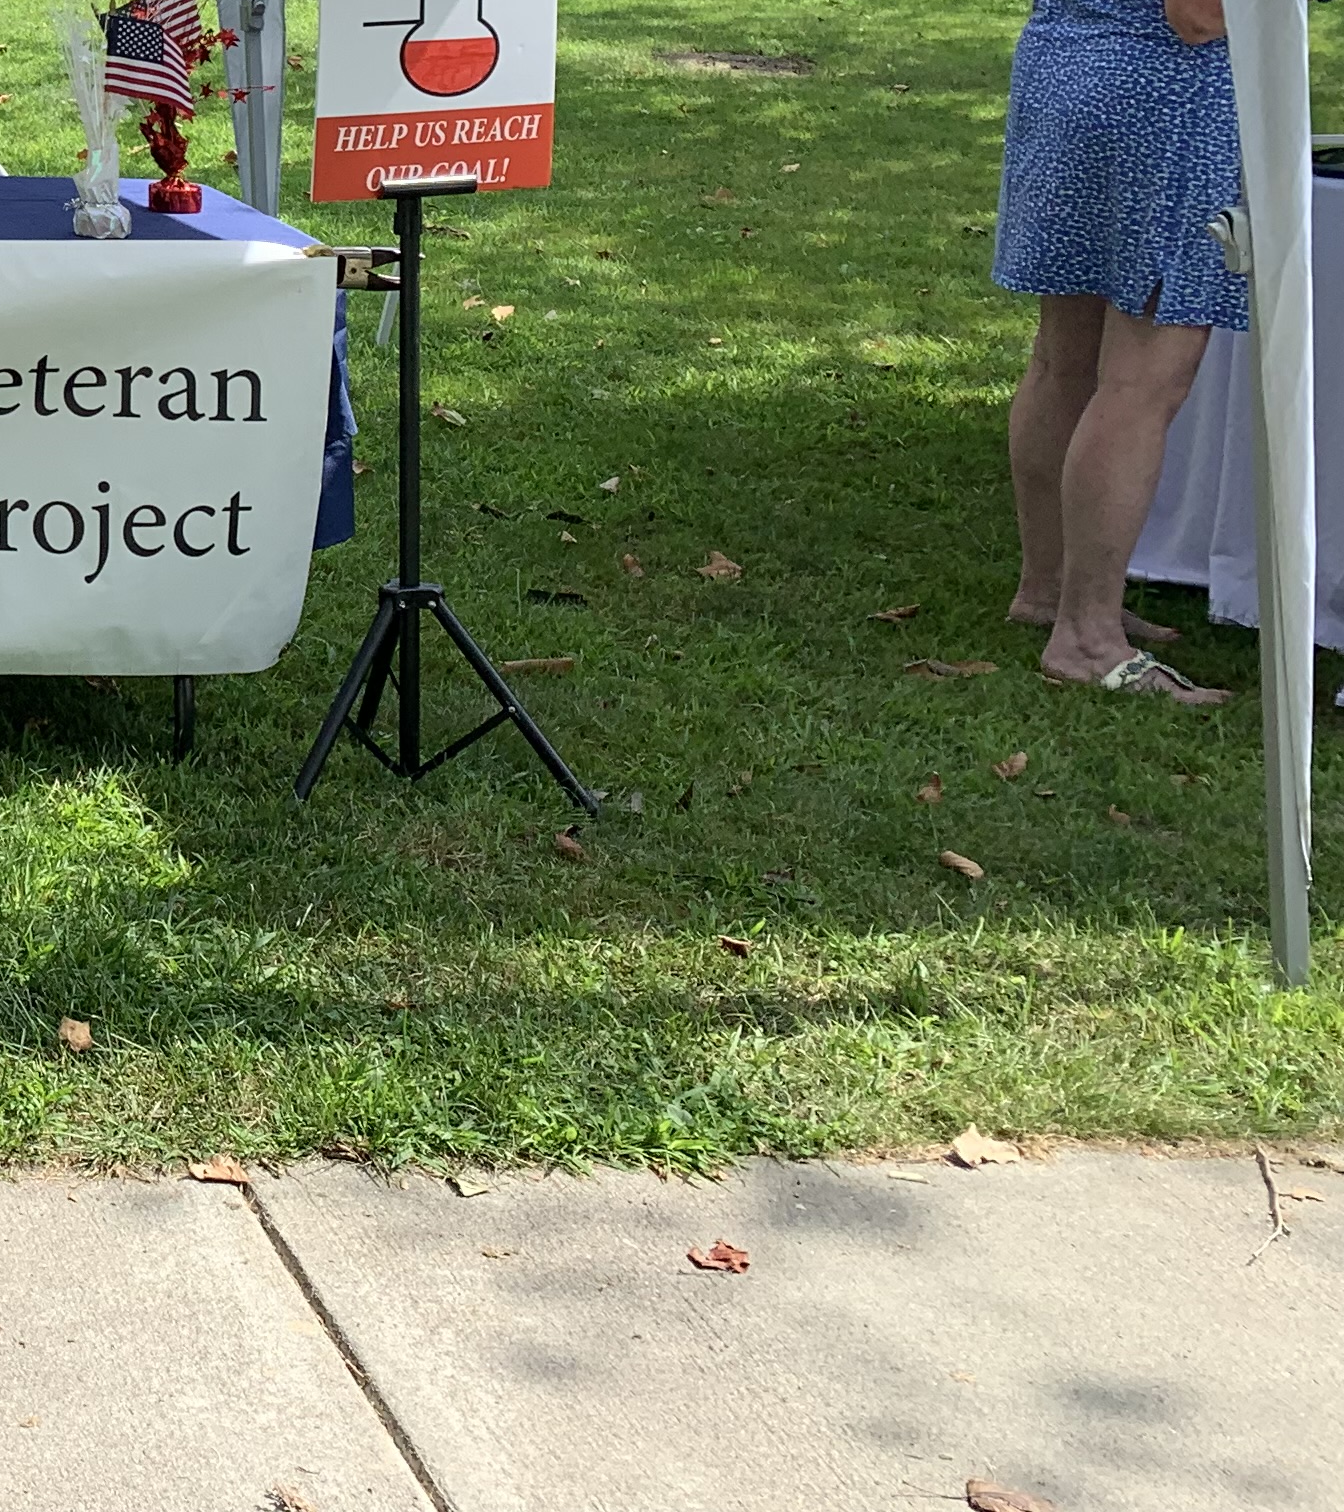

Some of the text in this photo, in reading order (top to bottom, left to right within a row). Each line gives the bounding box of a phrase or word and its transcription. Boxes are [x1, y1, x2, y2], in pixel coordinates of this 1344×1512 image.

[334, 114, 542, 152] HELP US REACH
